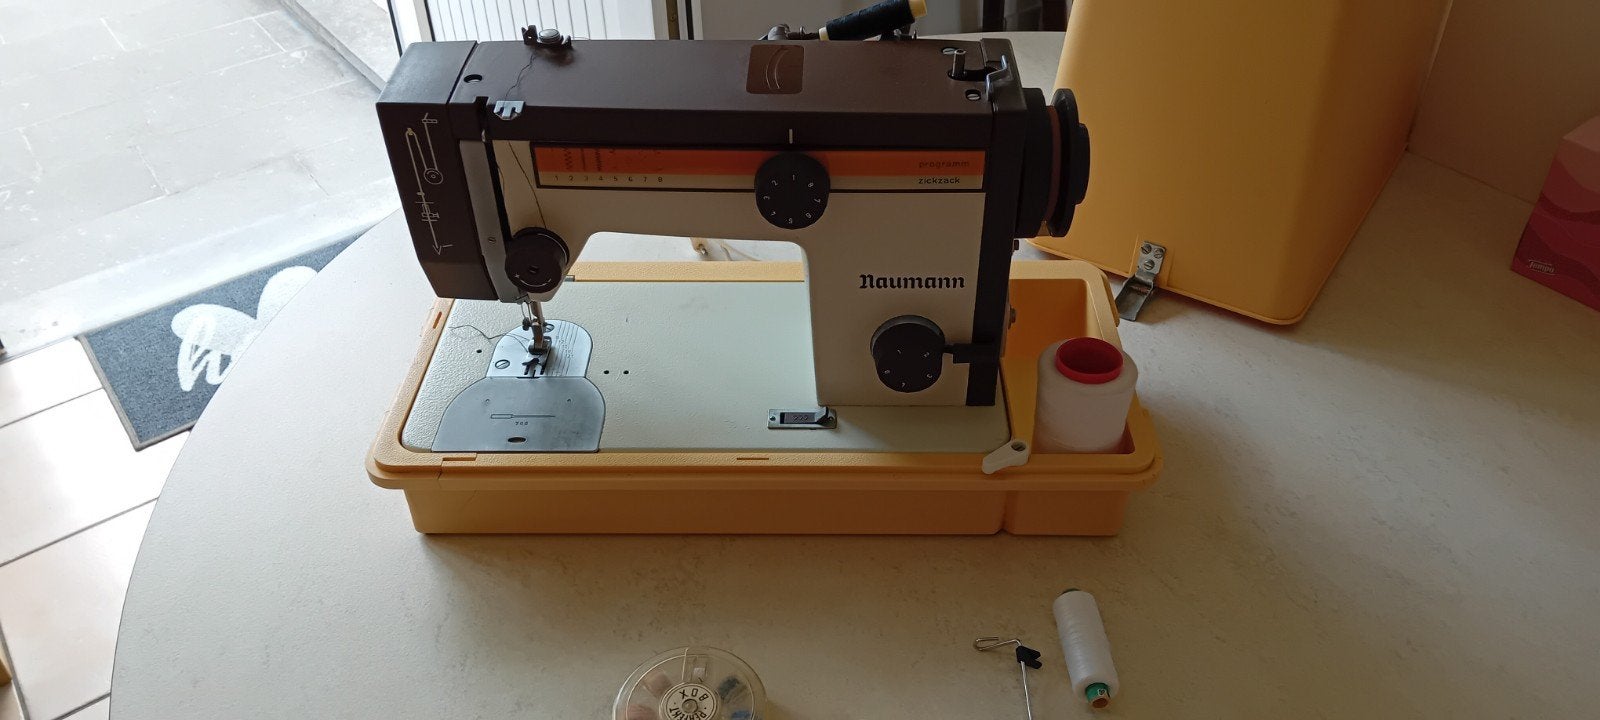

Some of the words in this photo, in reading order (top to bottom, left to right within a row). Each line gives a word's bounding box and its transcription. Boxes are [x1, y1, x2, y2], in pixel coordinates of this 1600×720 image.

[919, 161, 970, 169] programm
[918, 176, 960, 185] zickzack
[1529, 261, 1555, 273] Tempo
[859, 274, 965, 289] Naumann
[679, 688, 709, 701] BOX
